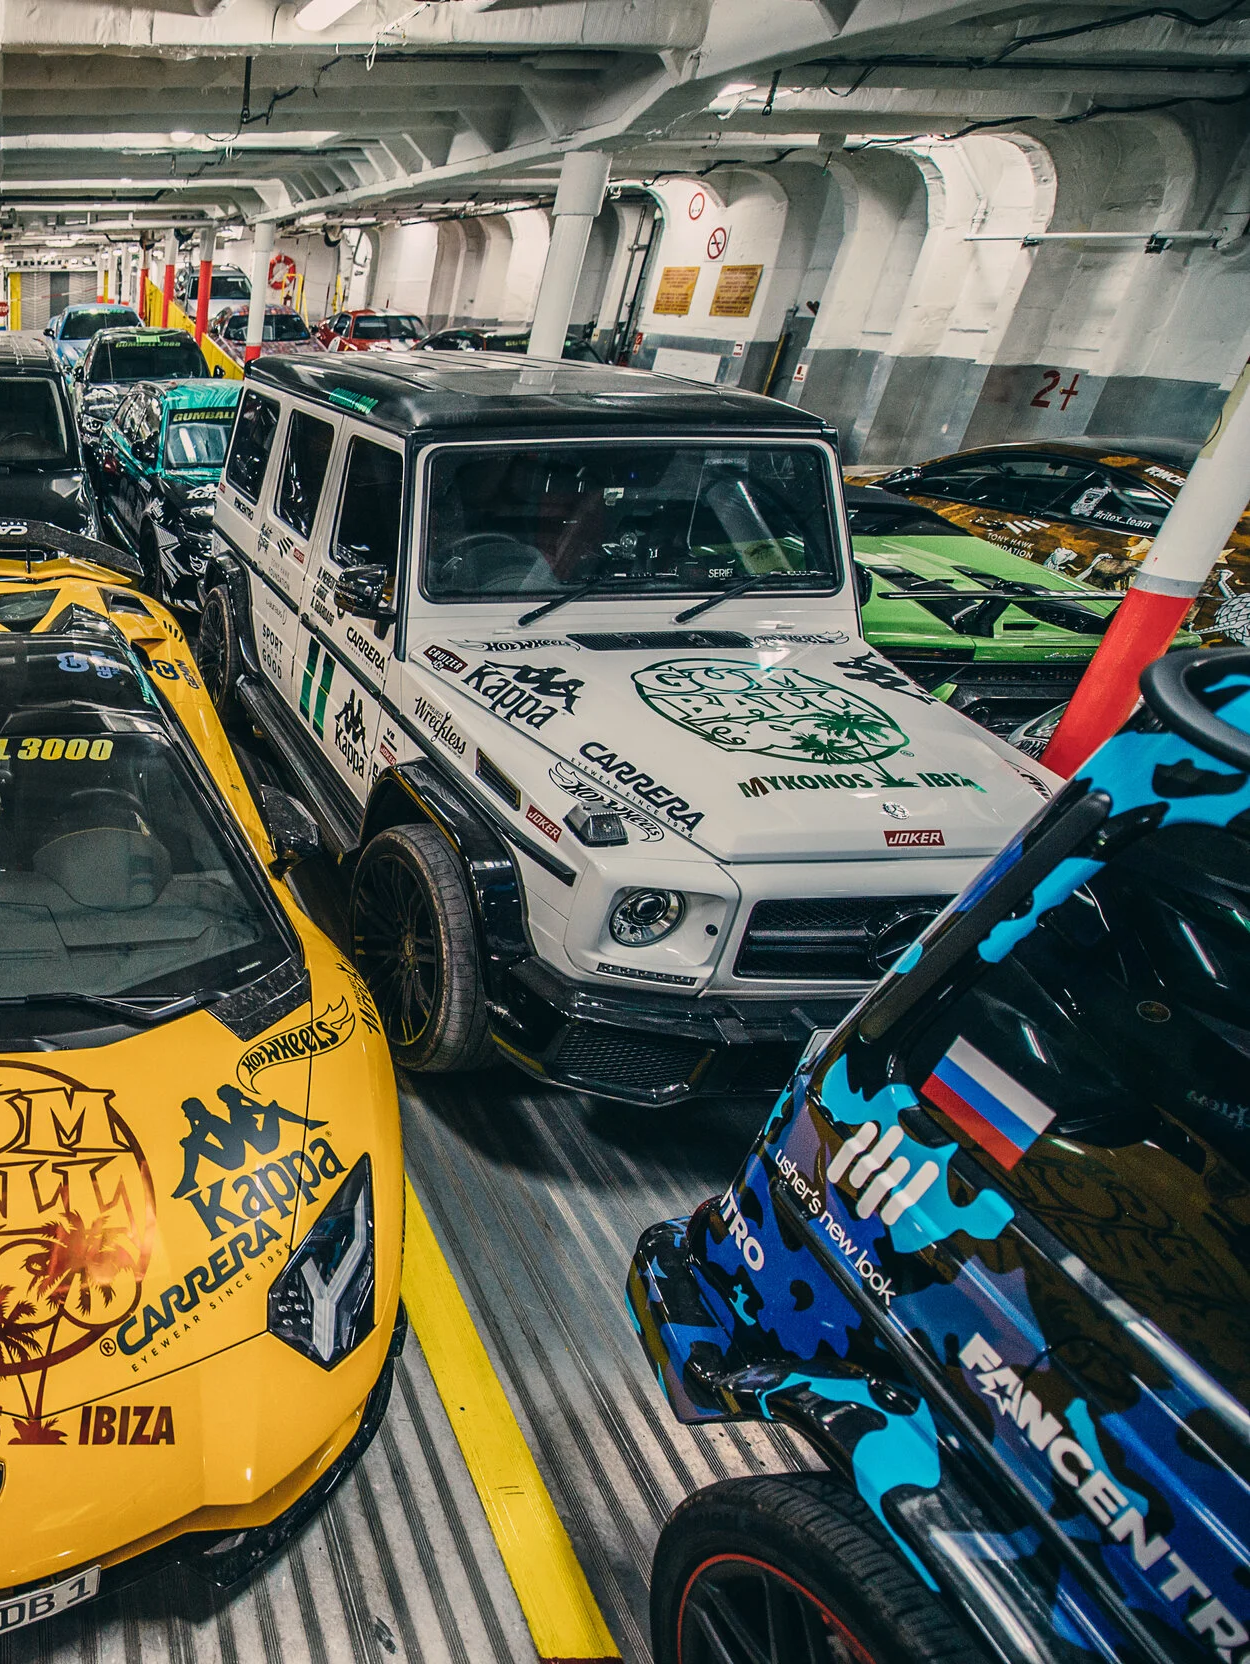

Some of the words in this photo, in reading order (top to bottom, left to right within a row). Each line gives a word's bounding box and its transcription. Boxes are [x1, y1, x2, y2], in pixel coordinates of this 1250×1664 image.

[1144, 465, 1186, 487] FANCE
[1093, 509, 1153, 530] #ritex_team
[987, 532, 1009, 546] TONY
[1010, 537, 1035, 551] HAWK
[262, 623, 284, 655] SPORT
[346, 626, 386, 674] CARRERA
[428, 647, 464, 672] CRUIZER
[262, 648, 283, 680] GOOD
[461, 663, 559, 731] Kappa
[415, 696, 468, 756] Wreckless
[21, 738, 114, 761] 3000
[334, 721, 365, 781] Kappa
[570, 756, 620, 791] EYEWEAR
[625, 791, 660, 816] SINCE
[665, 816, 694, 840] 1956
[579, 741, 706, 833] CARRERA
[737, 771, 875, 799] MYKONOS
[527, 809, 561, 840] JOKER
[887, 831, 945, 847] JOKER
[260, 1020, 339, 1063] WHEELS
[185, 1134, 348, 1243] Kappa
[775, 1148, 822, 1215] usher's
[818, 1209, 859, 1257] new
[854, 1249, 897, 1307] look
[115, 1220, 282, 1356] CARRERA
[130, 1314, 201, 1374] EYEWEAR
[208, 1271, 254, 1310] SINCE
[258, 1240, 293, 1270] 1956
[78, 1405, 175, 1446] IBIZA
[958, 1331, 1250, 1664] FANCENTR
[65, 1576, 91, 1607] 1
